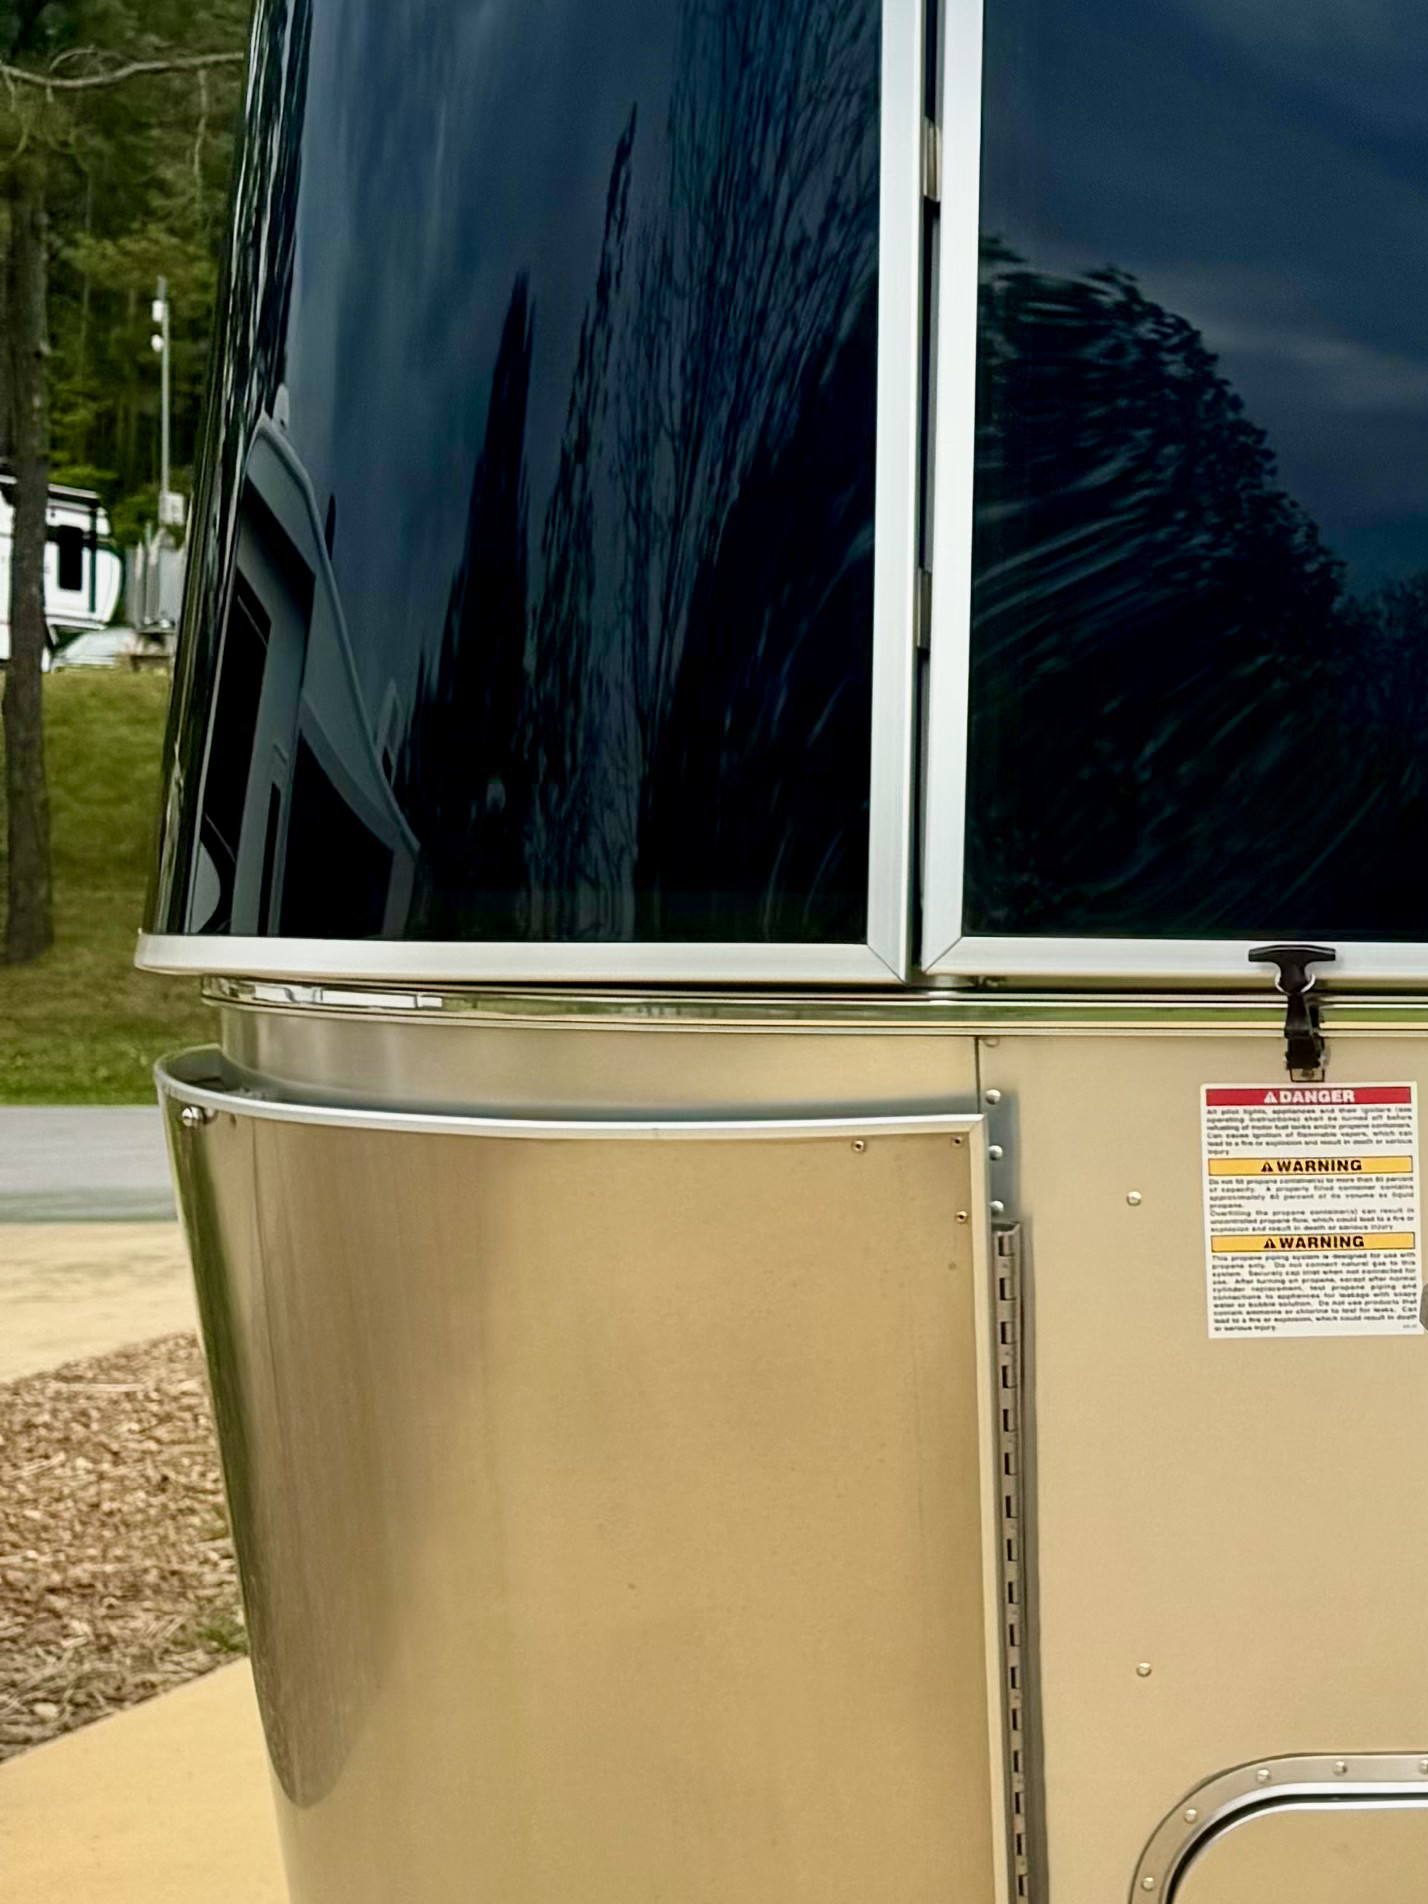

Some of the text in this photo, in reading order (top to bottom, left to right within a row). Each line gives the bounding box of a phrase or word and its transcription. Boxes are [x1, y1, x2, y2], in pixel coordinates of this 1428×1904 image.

[1279, 1090, 1355, 1104] DANGER
[1277, 1159, 1362, 1172] WARNING
[1279, 1236, 1365, 1249] WARNING
